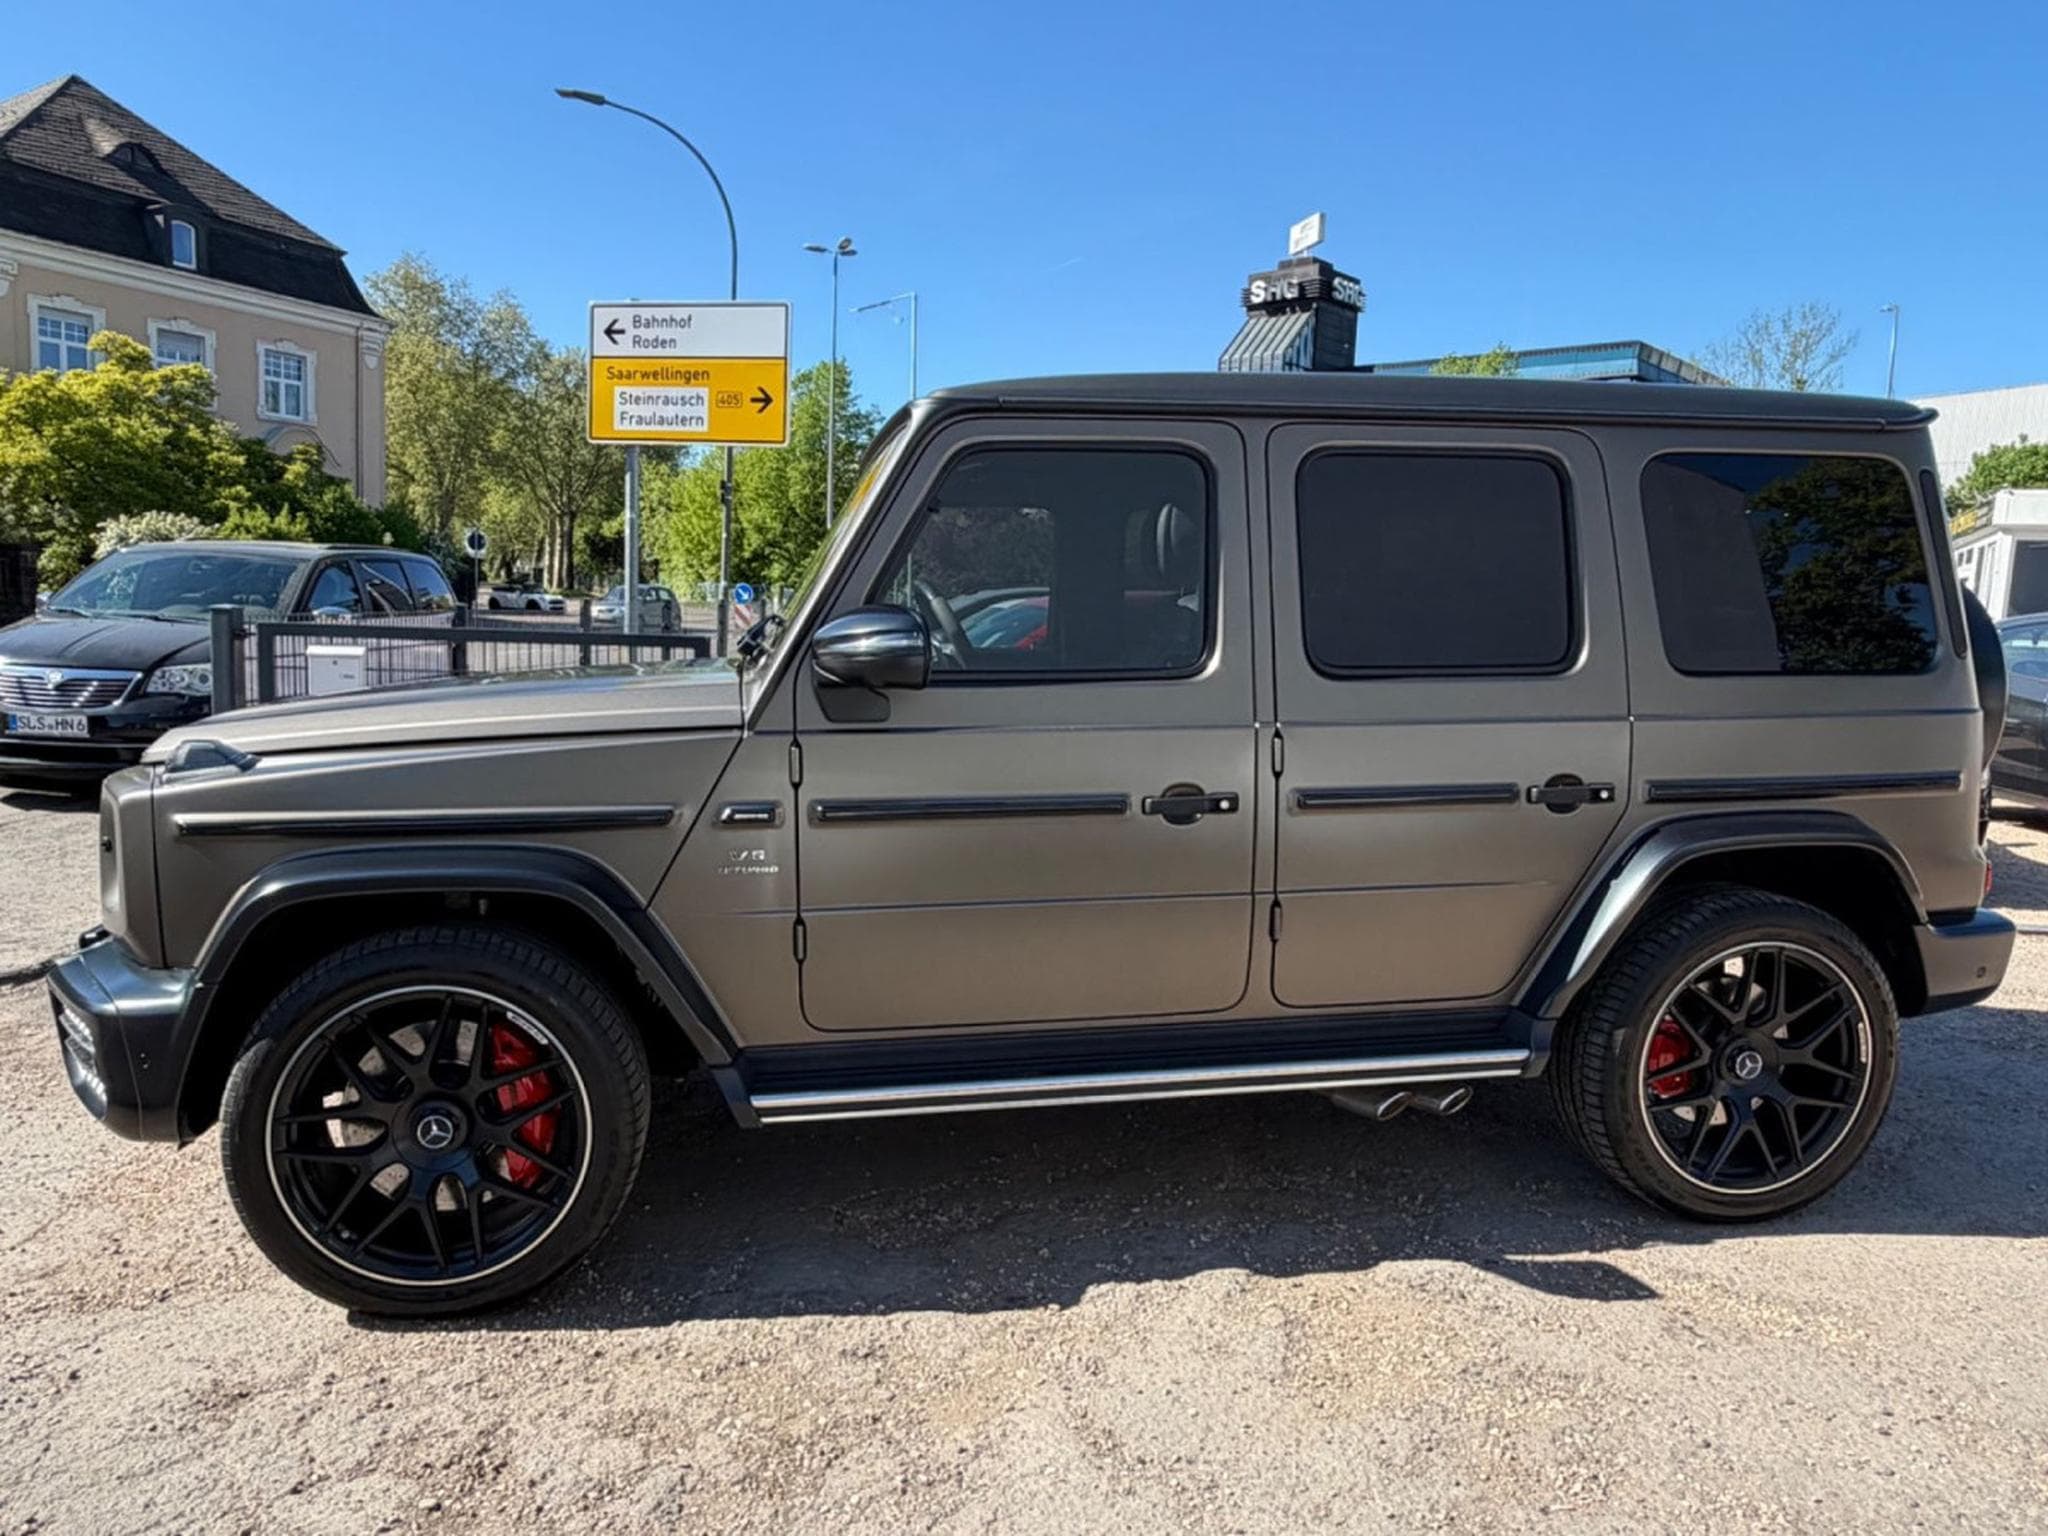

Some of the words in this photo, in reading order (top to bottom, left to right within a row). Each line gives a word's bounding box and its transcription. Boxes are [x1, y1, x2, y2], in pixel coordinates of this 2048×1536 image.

[1250, 277, 1299, 303] SHG
[632, 314, 692, 329] Bahnhof
[632, 335, 677, 349] Roden
[606, 366, 710, 384] Saarwellingen
[618, 391, 705, 406] Steinrausch
[720, 394, 740, 406] 405
[619, 411, 705, 427] Fraulautern
